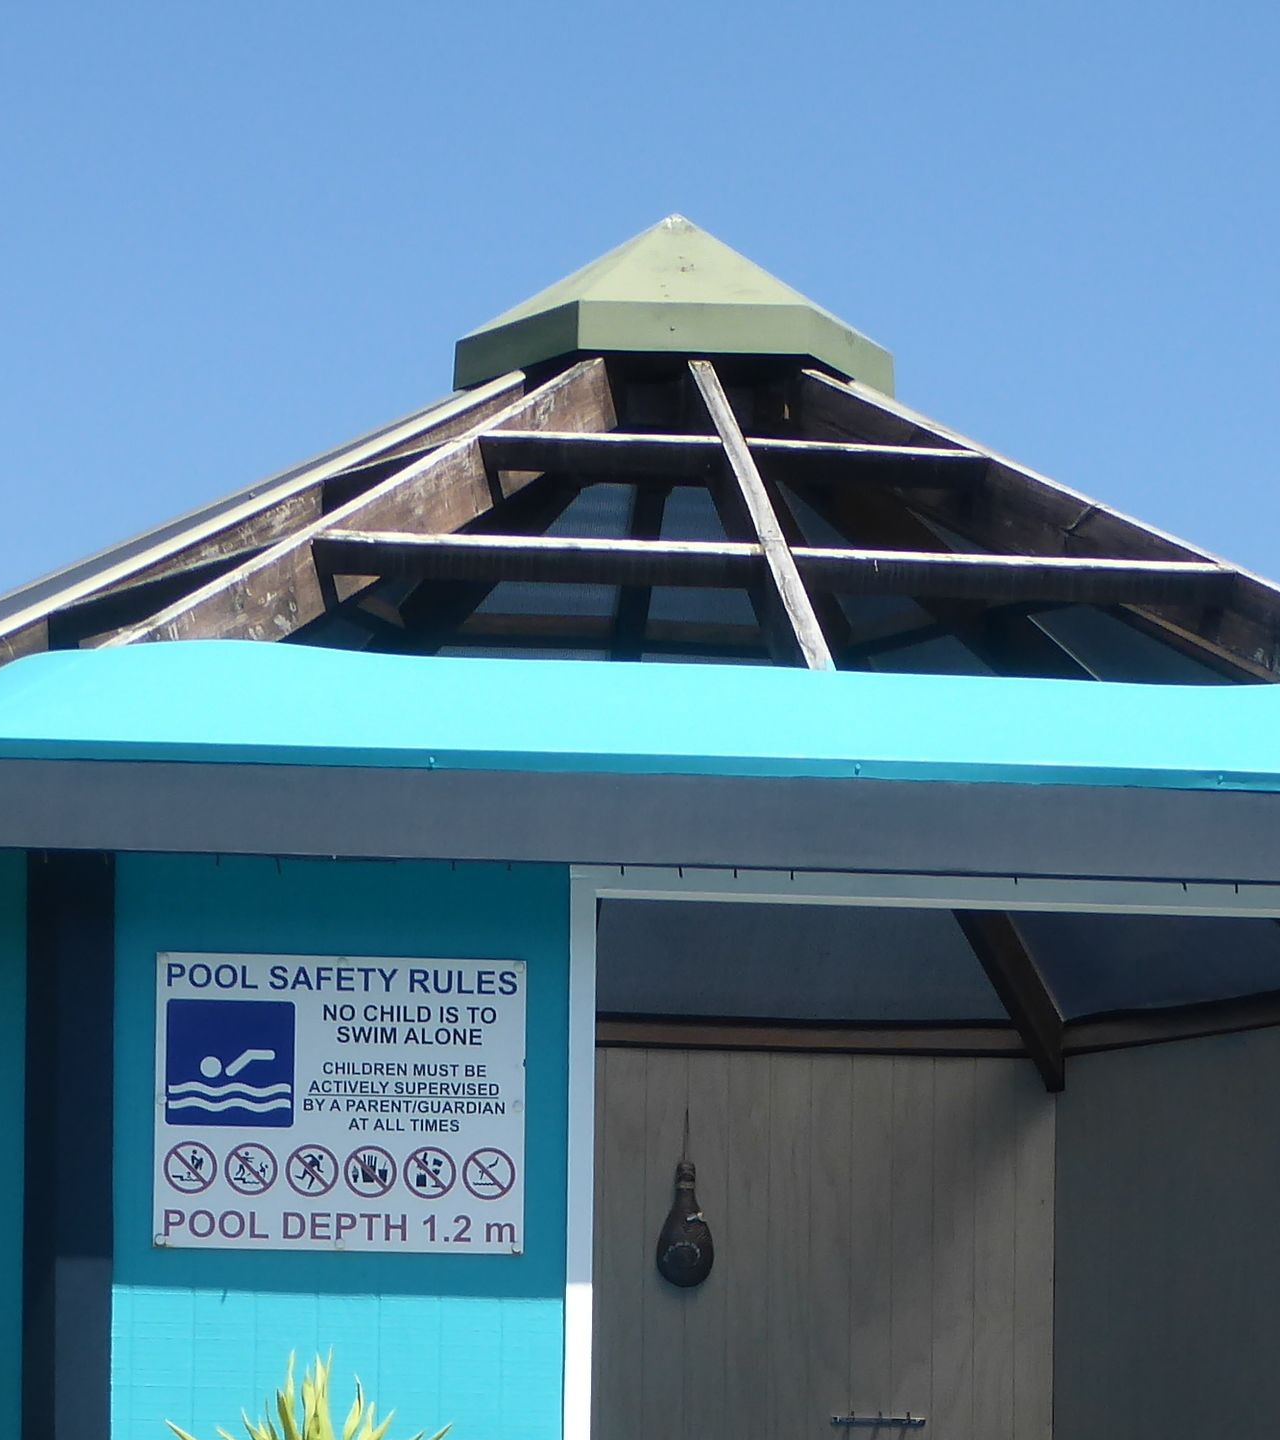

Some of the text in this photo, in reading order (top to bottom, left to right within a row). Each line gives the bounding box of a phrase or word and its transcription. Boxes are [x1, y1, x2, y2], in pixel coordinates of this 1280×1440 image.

[166, 962, 518, 996] POOL SAFETY RULES
[323, 1003, 497, 1025] NO CHILD IS TO
[336, 1025, 483, 1046] SWIM ALONE
[322, 1061, 487, 1078] CHILDREN MUST BE
[308, 1080, 500, 1096] ACTIVELY SUPERVISED
[303, 1098, 506, 1115] BY A PARENT/GUARDIAN
[348, 1117, 460, 1133] AT ALL TIMES
[162, 1208, 516, 1244] POOL DEPTH 1.2 m
